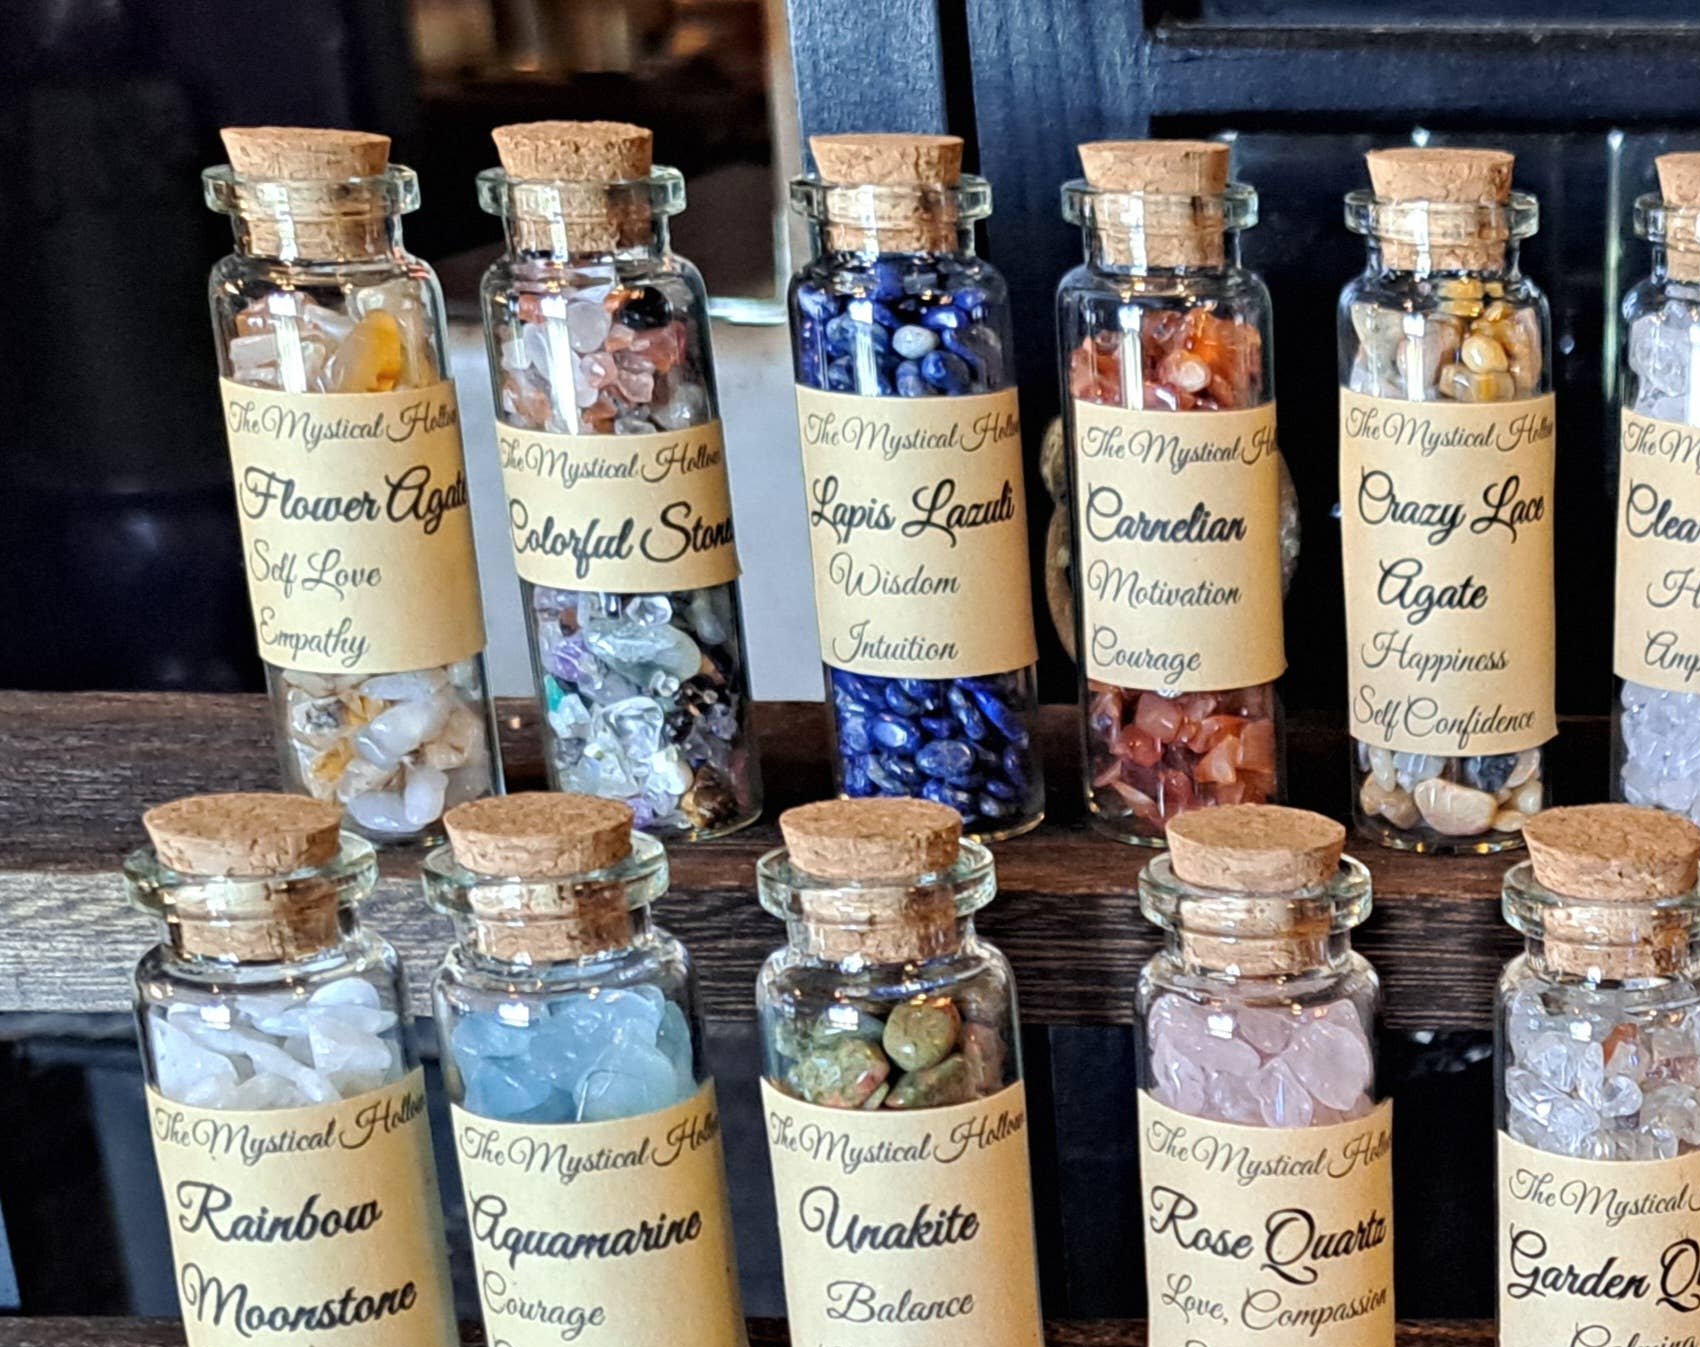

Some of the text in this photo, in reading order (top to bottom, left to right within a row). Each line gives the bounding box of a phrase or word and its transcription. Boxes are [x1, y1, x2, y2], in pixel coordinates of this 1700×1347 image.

[262, 407, 383, 452] Mystical
[842, 417, 959, 459] Mystical
[1081, 426, 1126, 459] The
[1128, 428, 1241, 475] Mystical
[1383, 414, 1494, 457] Mystical
[240, 466, 379, 521] Flower
[525, 441, 638, 489] Mystical
[811, 476, 1015, 548] Lapis Lazuli
[1085, 482, 1247, 542] Carnelian
[1358, 466, 1544, 545] Crazy Lace
[509, 500, 633, 578] Colorful
[249, 539, 382, 600] Self Love
[830, 552, 960, 597] Wisdom
[1087, 559, 1242, 607] Motivation
[1377, 557, 1489, 626] Agate
[258, 607, 370, 666] Empathy
[833, 620, 959, 662] Intuition
[1091, 623, 1201, 684] Courage
[1361, 630, 1509, 683] Happiness
[1354, 685, 1536, 749] Self Confidence
[192, 1116, 337, 1166] Mystical
[507, 1135, 650, 1185] Mystical
[798, 1123, 932, 1175] Mystical
[1146, 1120, 1327, 1185] The Mystical
[176, 1179, 382, 1243] Rainbow
[800, 1186, 980, 1254] Unakite
[1508, 1168, 1557, 1208] The
[1559, 1180, 1689, 1227] Mystical
[469, 1188, 702, 1270] Aquamarine
[1150, 1186, 1387, 1285] Rose Quartz
[1507, 1222, 1651, 1299] Garden
[181, 1262, 417, 1338] Moonstone
[480, 1267, 606, 1341] Courage
[826, 1281, 975, 1325] Balance
[1162, 1273, 1388, 1338] Love, Compassion
